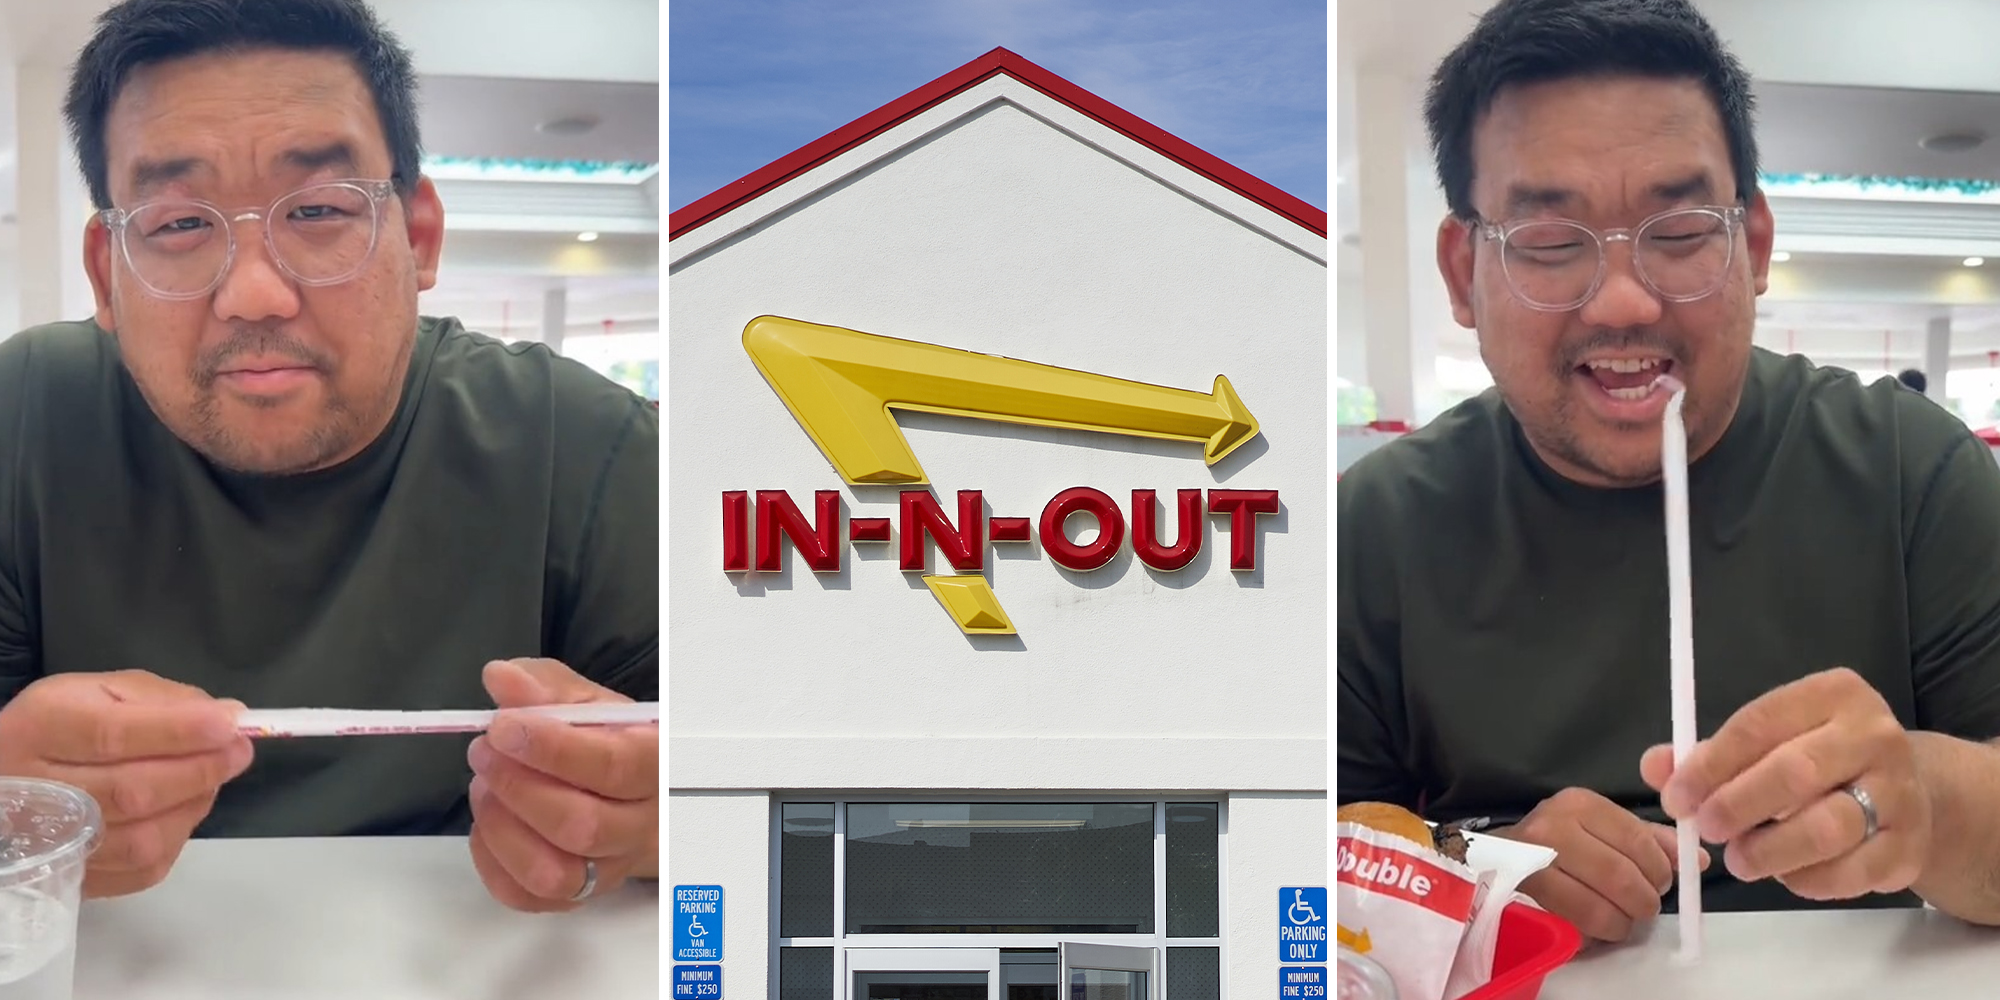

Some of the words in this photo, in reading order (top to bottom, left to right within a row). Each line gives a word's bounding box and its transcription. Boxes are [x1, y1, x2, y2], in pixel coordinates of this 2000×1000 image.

[722, 486, 1279, 573] IN-N-OUT
[677, 889, 719, 901] RESERVED
[680, 902, 716, 913] PARKING
[1281, 926, 1325, 940] PARKING
[691, 938, 705, 948] VAN
[678, 948, 716, 957] ACCESSIBLE
[1289, 944, 1317, 958] ONLY
[681, 971, 713, 981] MINIMUM
[1287, 973, 1320, 983] MINIMUM
[677, 984, 693, 995] FINE
[697, 983, 717, 995] $250
[1283, 986, 1300, 996] FINE
[1303, 985, 1324, 996] $250
